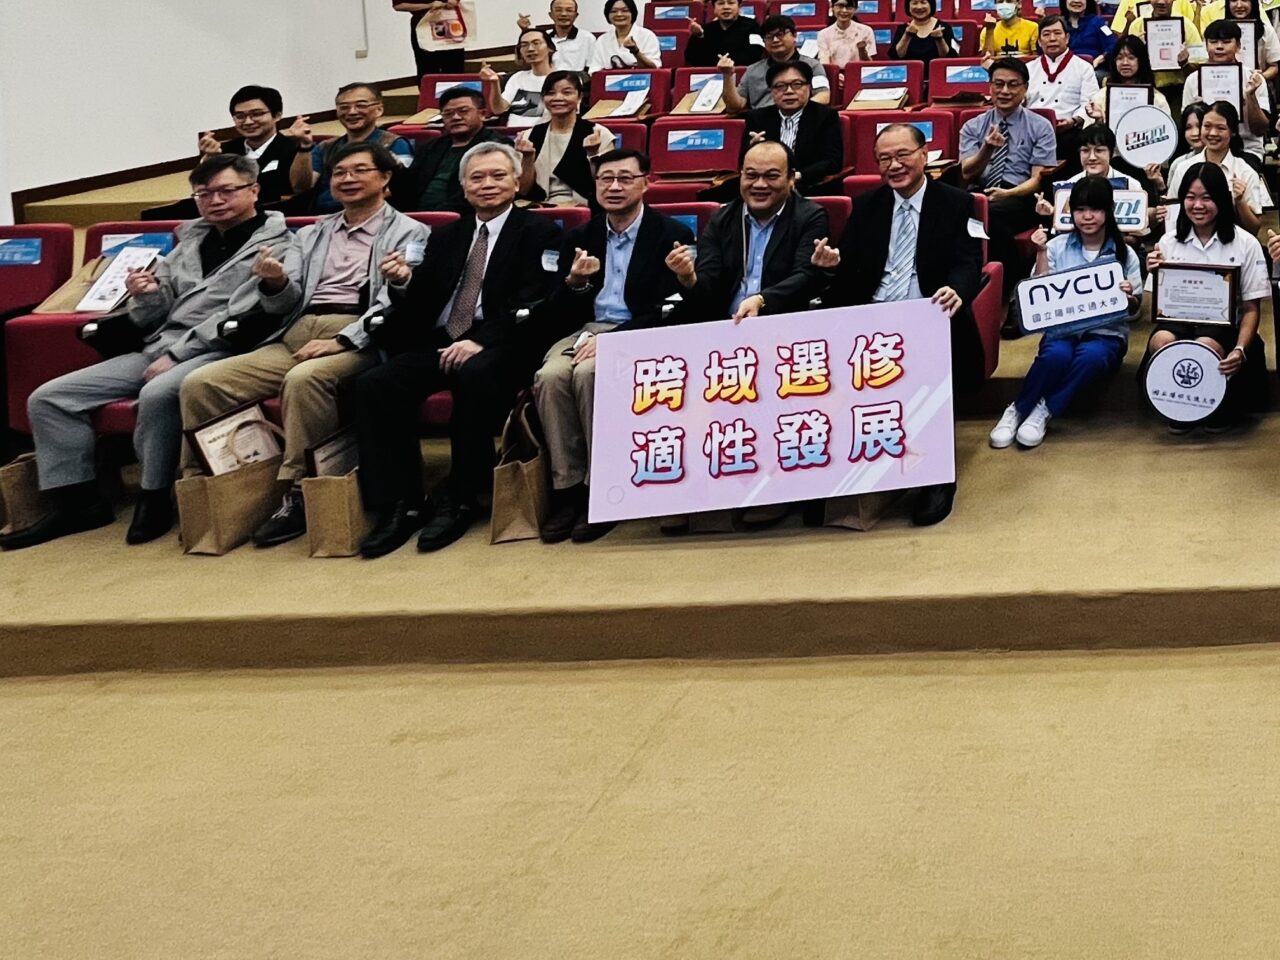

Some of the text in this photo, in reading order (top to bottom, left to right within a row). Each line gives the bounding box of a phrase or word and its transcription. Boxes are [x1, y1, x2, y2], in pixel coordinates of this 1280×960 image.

[1032, 297, 1118, 323] 國立陽明交通大學
[631, 332, 905, 415] 跨域選修
[631, 400, 906, 487] 適性發展
